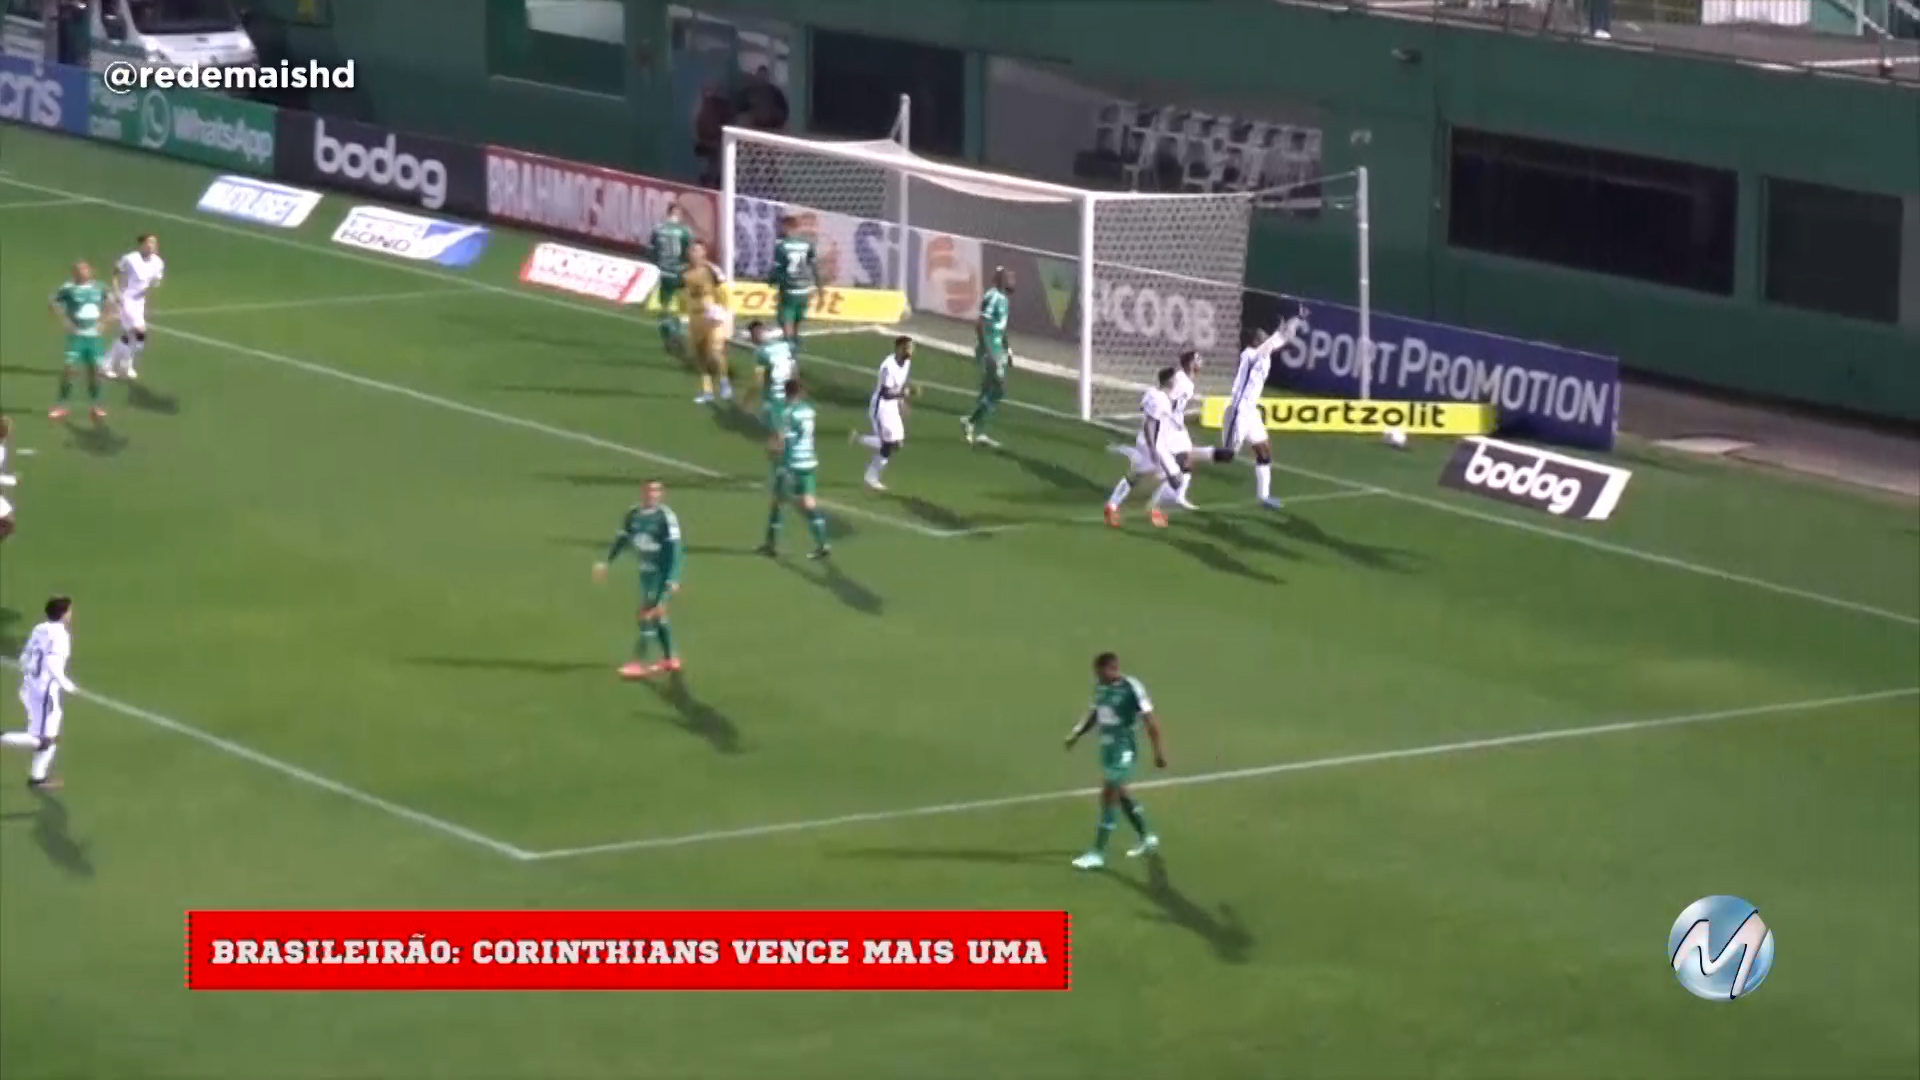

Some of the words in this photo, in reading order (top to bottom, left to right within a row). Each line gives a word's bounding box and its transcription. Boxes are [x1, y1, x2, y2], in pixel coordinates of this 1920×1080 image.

[172, 105, 273, 164] WhatsApp
[314, 117, 448, 209] bodog
[1398, 337, 1608, 426] PROMOTION
[1464, 443, 1582, 515] bodog
